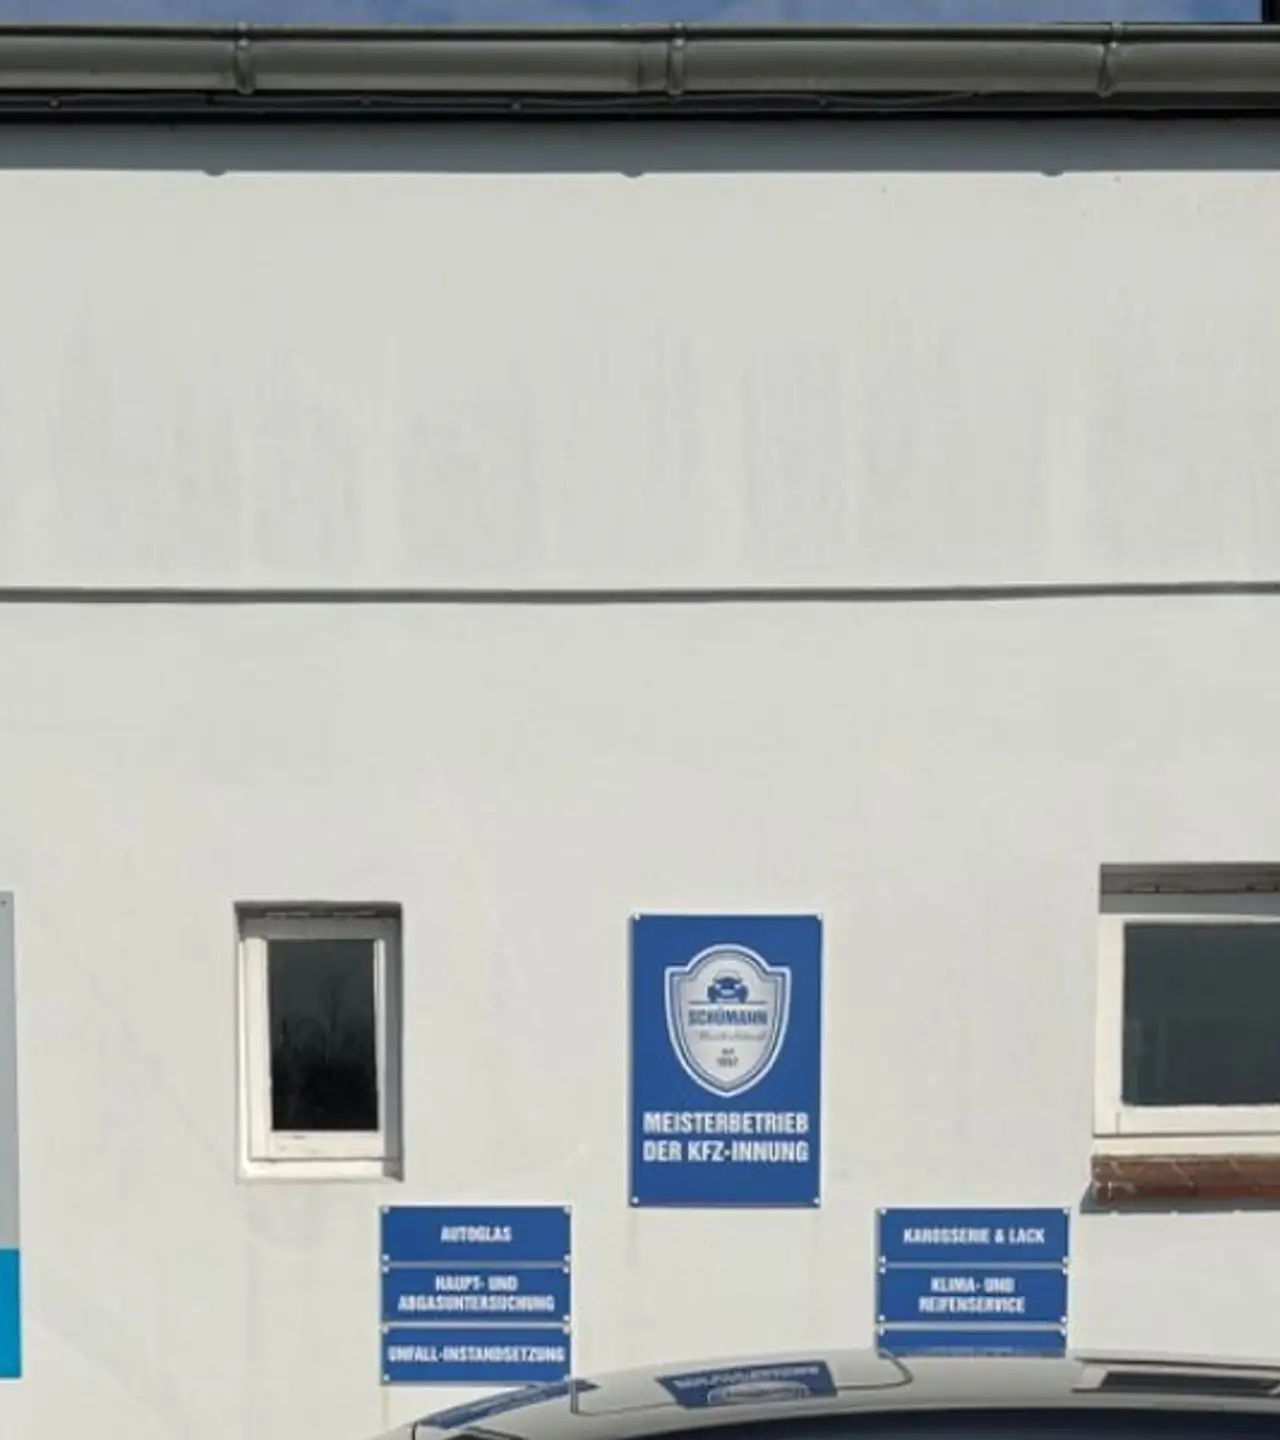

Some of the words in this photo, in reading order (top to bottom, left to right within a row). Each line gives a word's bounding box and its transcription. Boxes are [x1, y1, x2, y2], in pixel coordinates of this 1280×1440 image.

[642, 1111, 809, 1134] MEISTERBETRIEB
[642, 1140, 682, 1162] DER
[687, 1140, 809, 1162] KFZ-INNUNG
[440, 1225, 512, 1243] AUTOGLAS
[903, 1228, 990, 1244] KAROSSERIE
[994, 1228, 1006, 1244] &
[1008, 1228, 1046, 1244] LACK
[435, 1275, 484, 1292] HAUPT-
[488, 1275, 519, 1292] UND
[930, 1277, 981, 1293] KLIMA-
[983, 1277, 1016, 1293] UND
[397, 1294, 556, 1312] ABGASUNTERSUCHUNG
